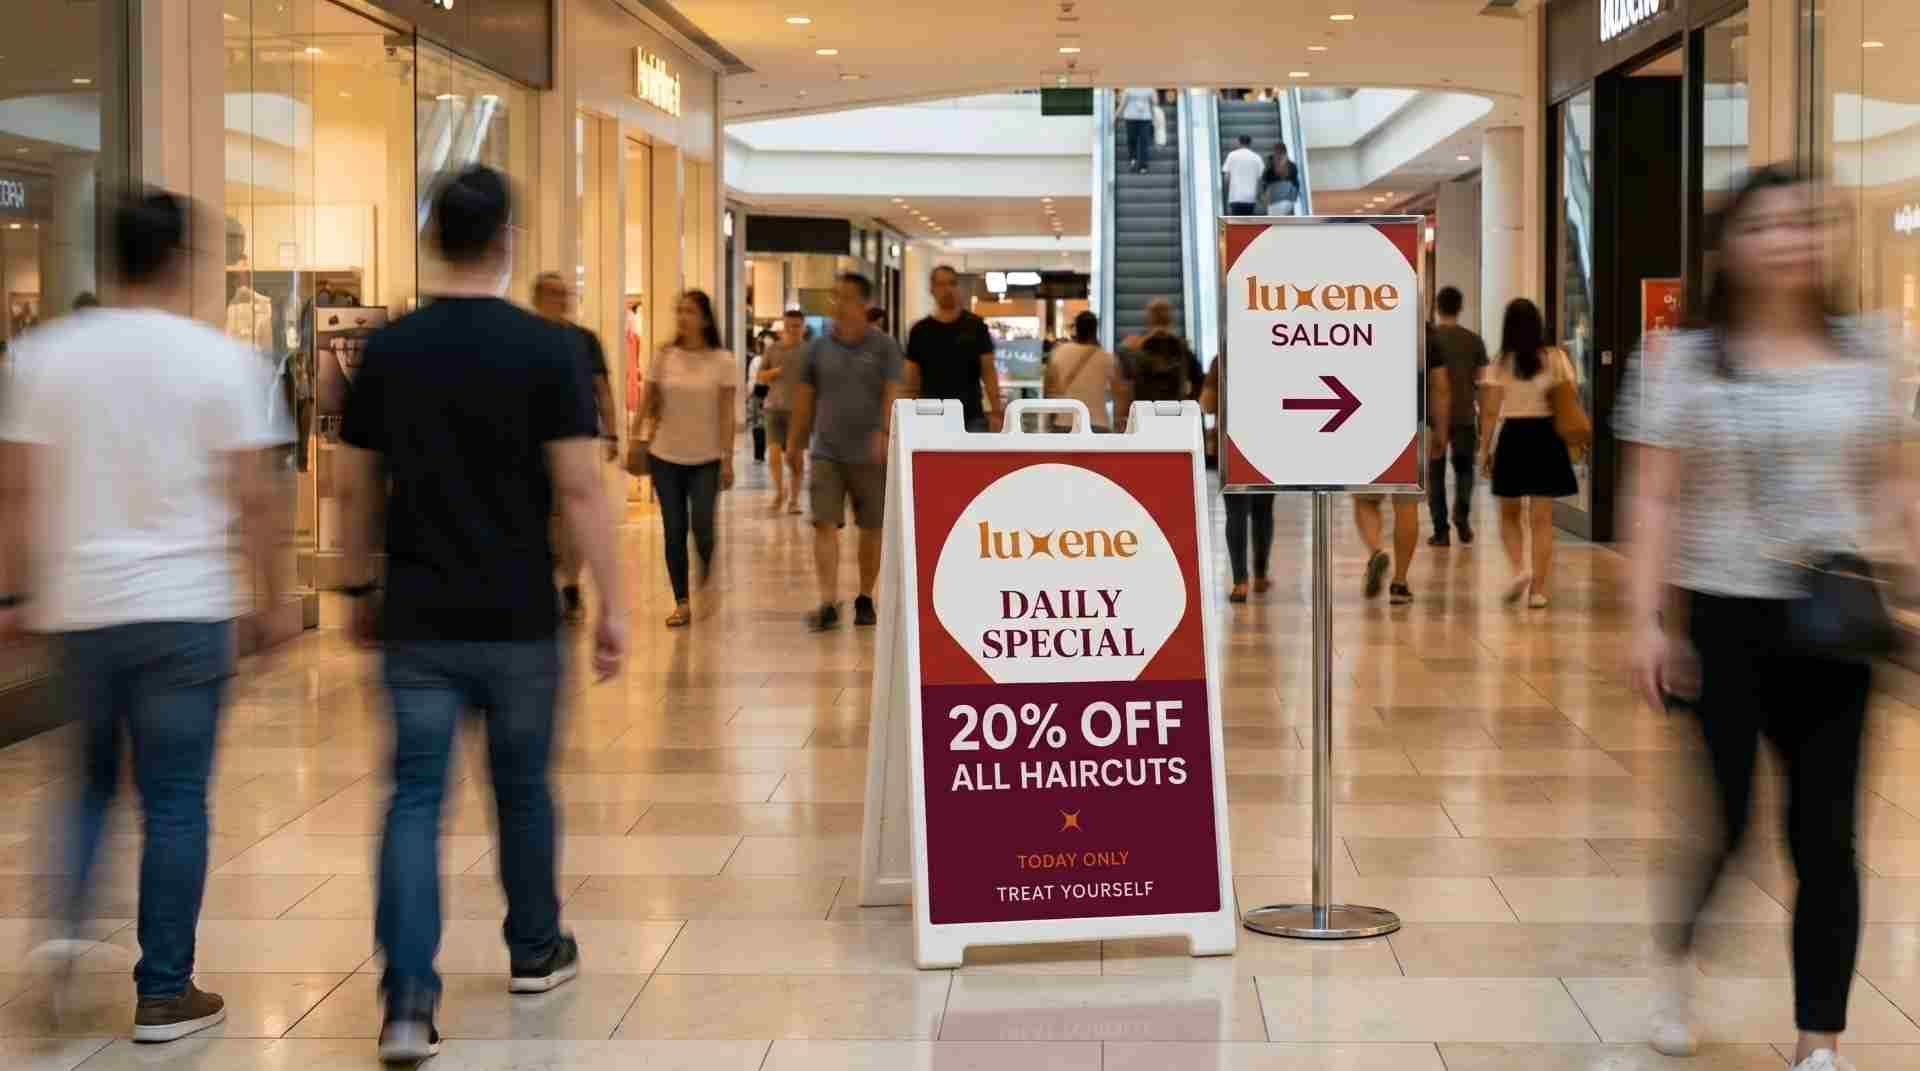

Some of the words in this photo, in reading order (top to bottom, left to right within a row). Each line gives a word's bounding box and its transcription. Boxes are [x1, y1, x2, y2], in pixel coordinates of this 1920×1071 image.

[1246, 275, 1399, 312] luxene
[1271, 323, 1373, 347] SALON
[978, 520, 1139, 560] luxene
[999, 589, 1123, 620] DAILY
[981, 627, 1146, 660] SPECIAL
[948, 702, 1068, 751] 20%
[1080, 700, 1184, 747] OFF
[951, 762, 1011, 791] ALL
[1020, 757, 1188, 789] HAIRCUTS
[1017, 852, 1078, 869] TODAY
[1083, 850, 1129, 866] ONLY
[996, 885, 1055, 902] TREAT
[1060, 881, 1154, 899] YOURSELF
